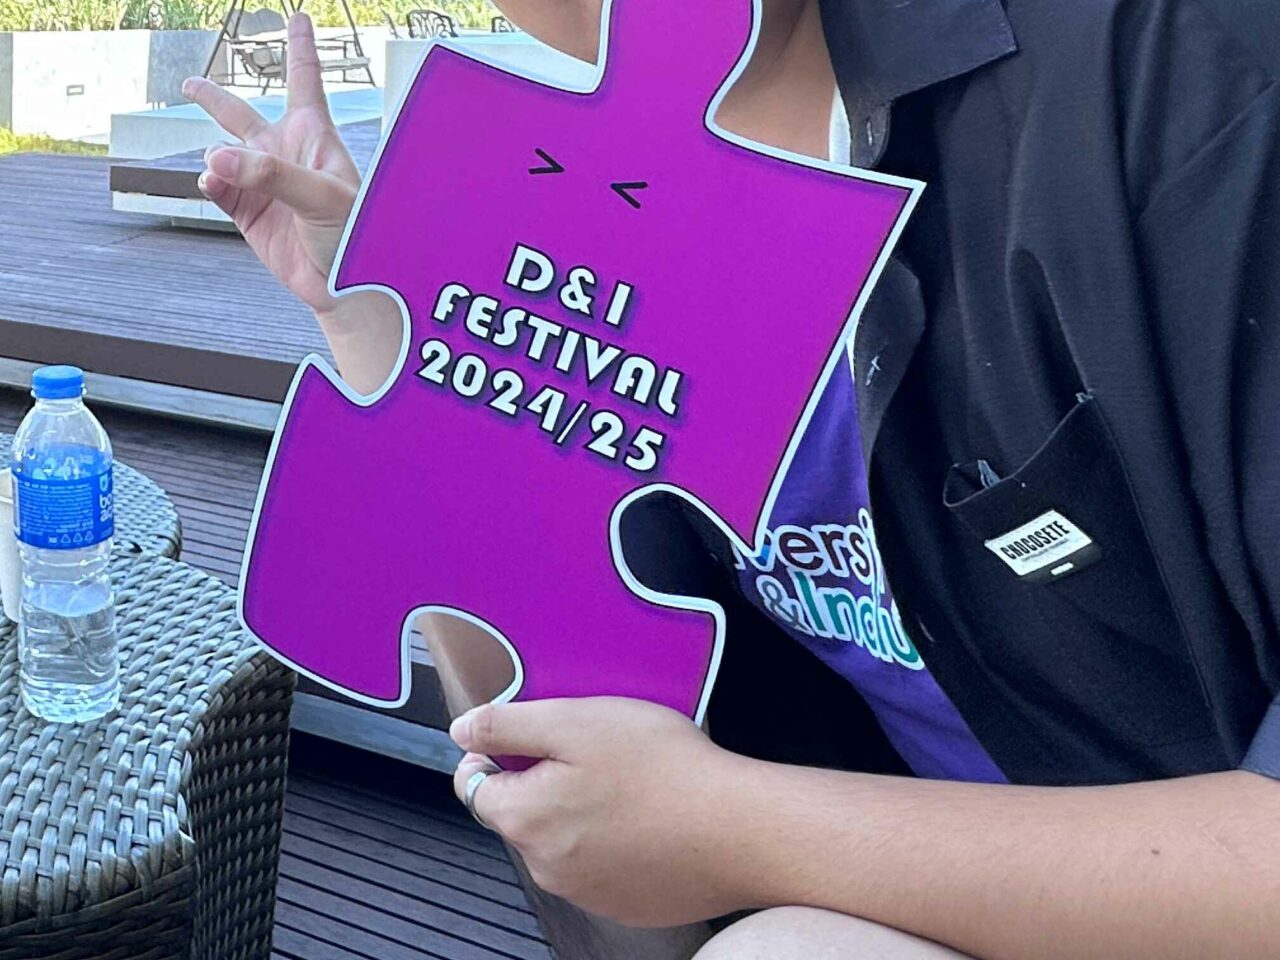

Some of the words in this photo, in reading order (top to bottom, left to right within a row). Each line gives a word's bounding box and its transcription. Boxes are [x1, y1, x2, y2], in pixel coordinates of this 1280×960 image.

[414, 338, 667, 472] 2024/25
[431, 281, 684, 417] FESTIVAL
[1000, 520, 1070, 560] CHOCOSETE
